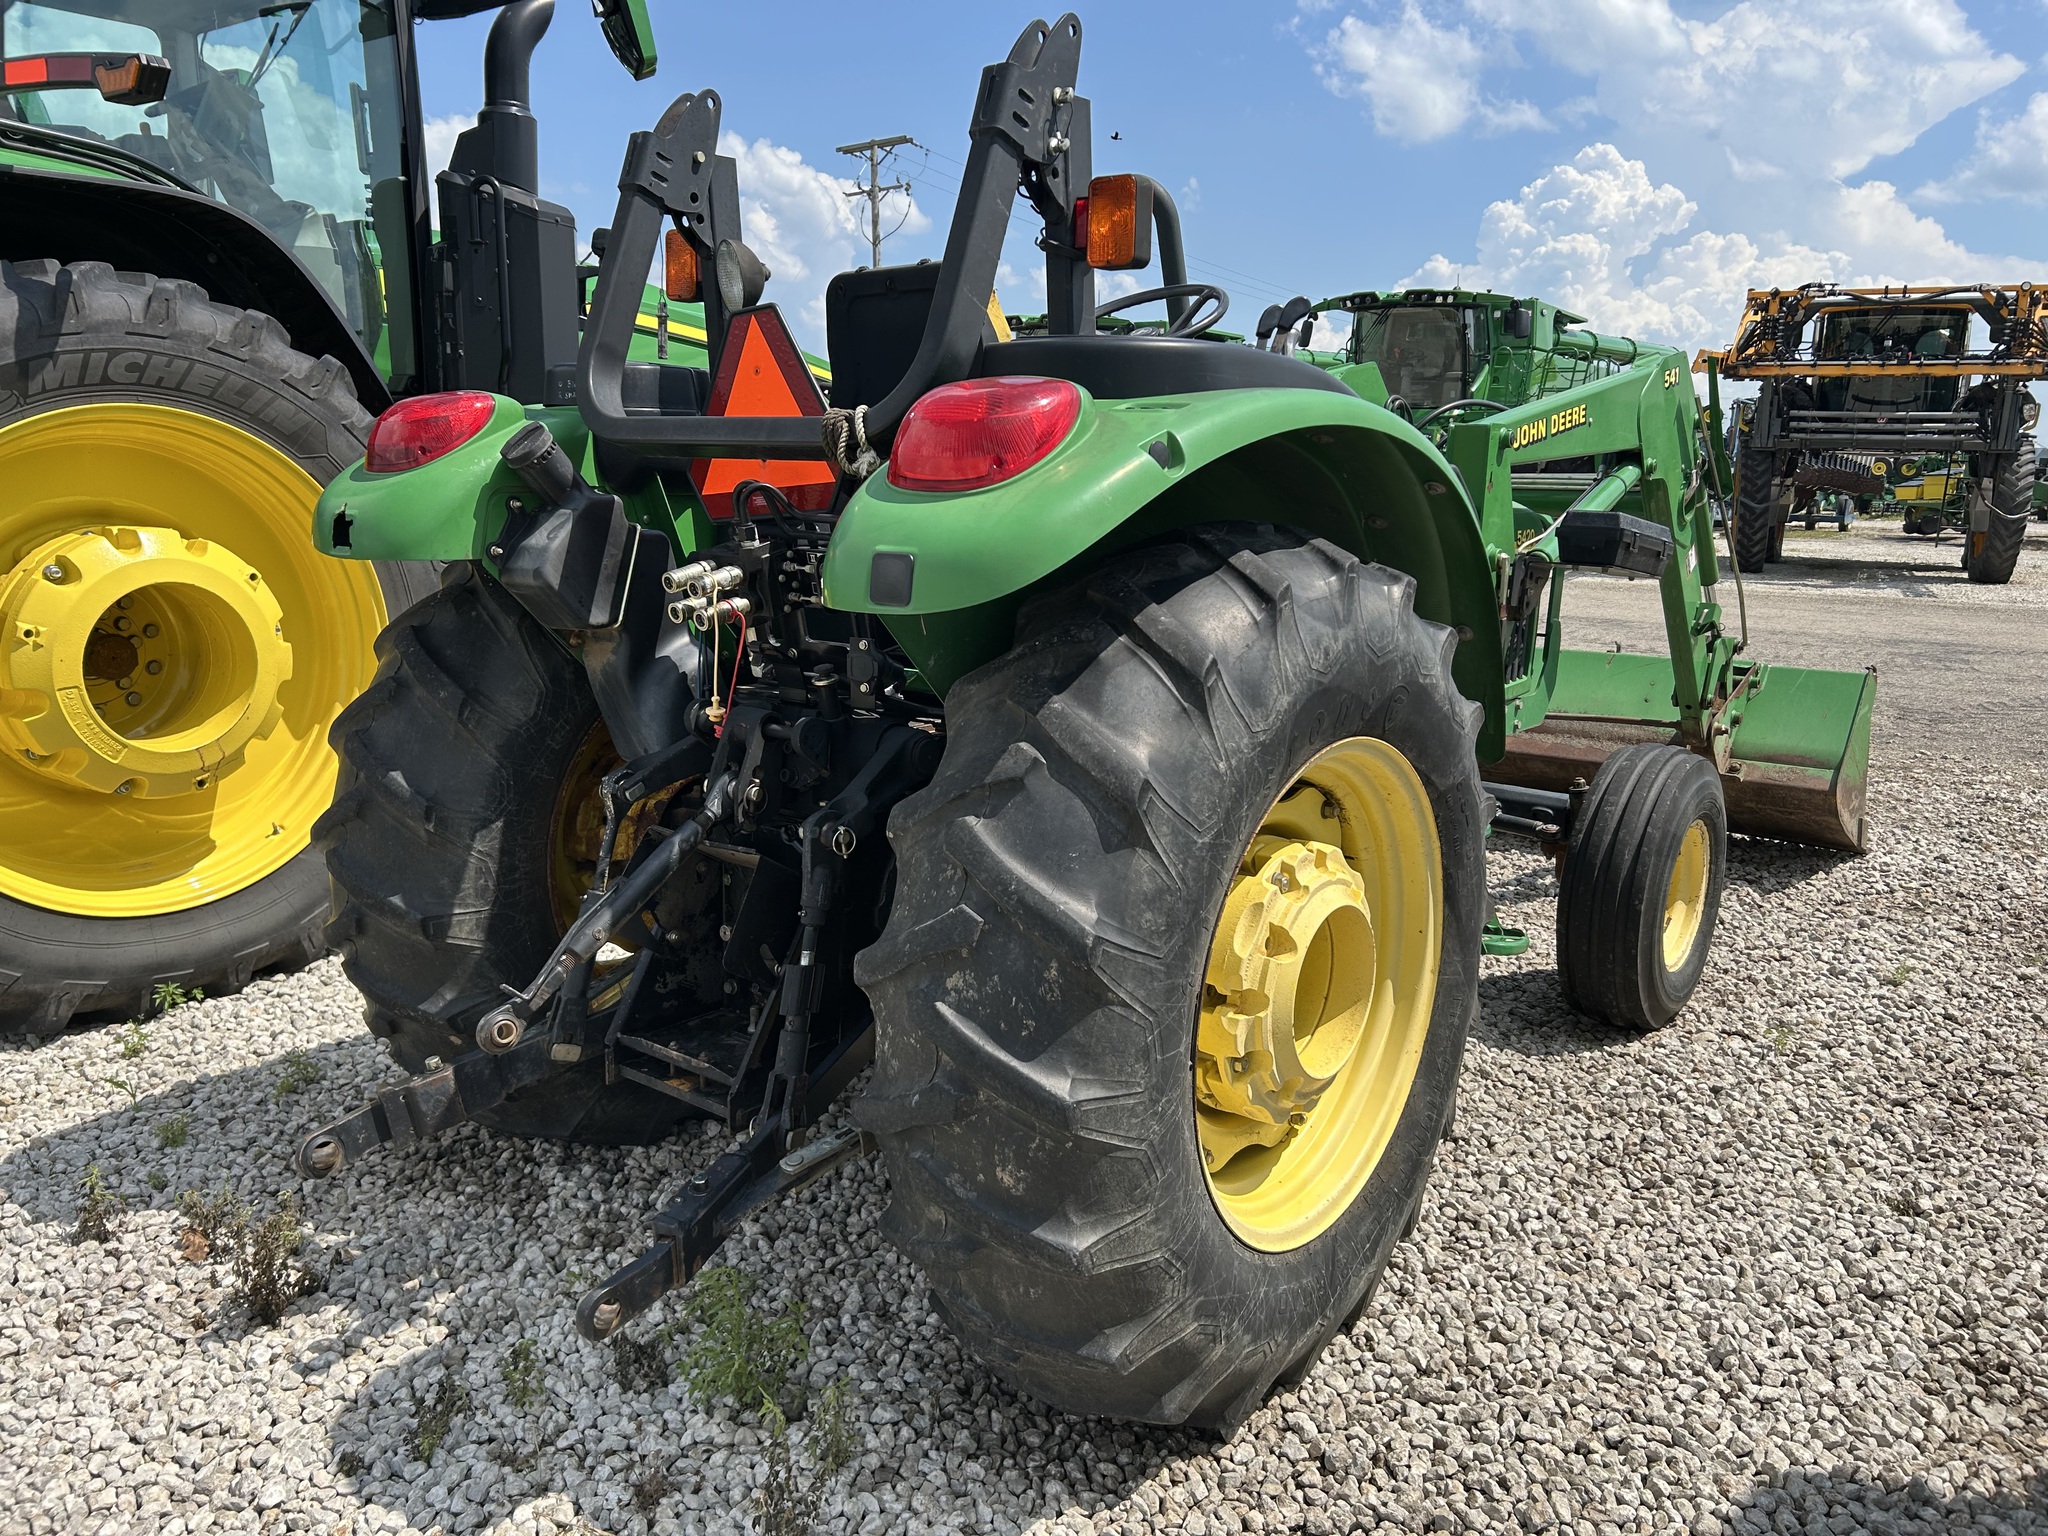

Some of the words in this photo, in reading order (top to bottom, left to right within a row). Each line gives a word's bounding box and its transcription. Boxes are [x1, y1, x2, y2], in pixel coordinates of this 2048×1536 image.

[27, 350, 310, 437] MICHELIN
[1664, 366, 1680, 390] 541
[1513, 417, 1547, 450] JOHN
[1550, 404, 1587, 437] DEERE
[1517, 528, 1535, 546] 5420
